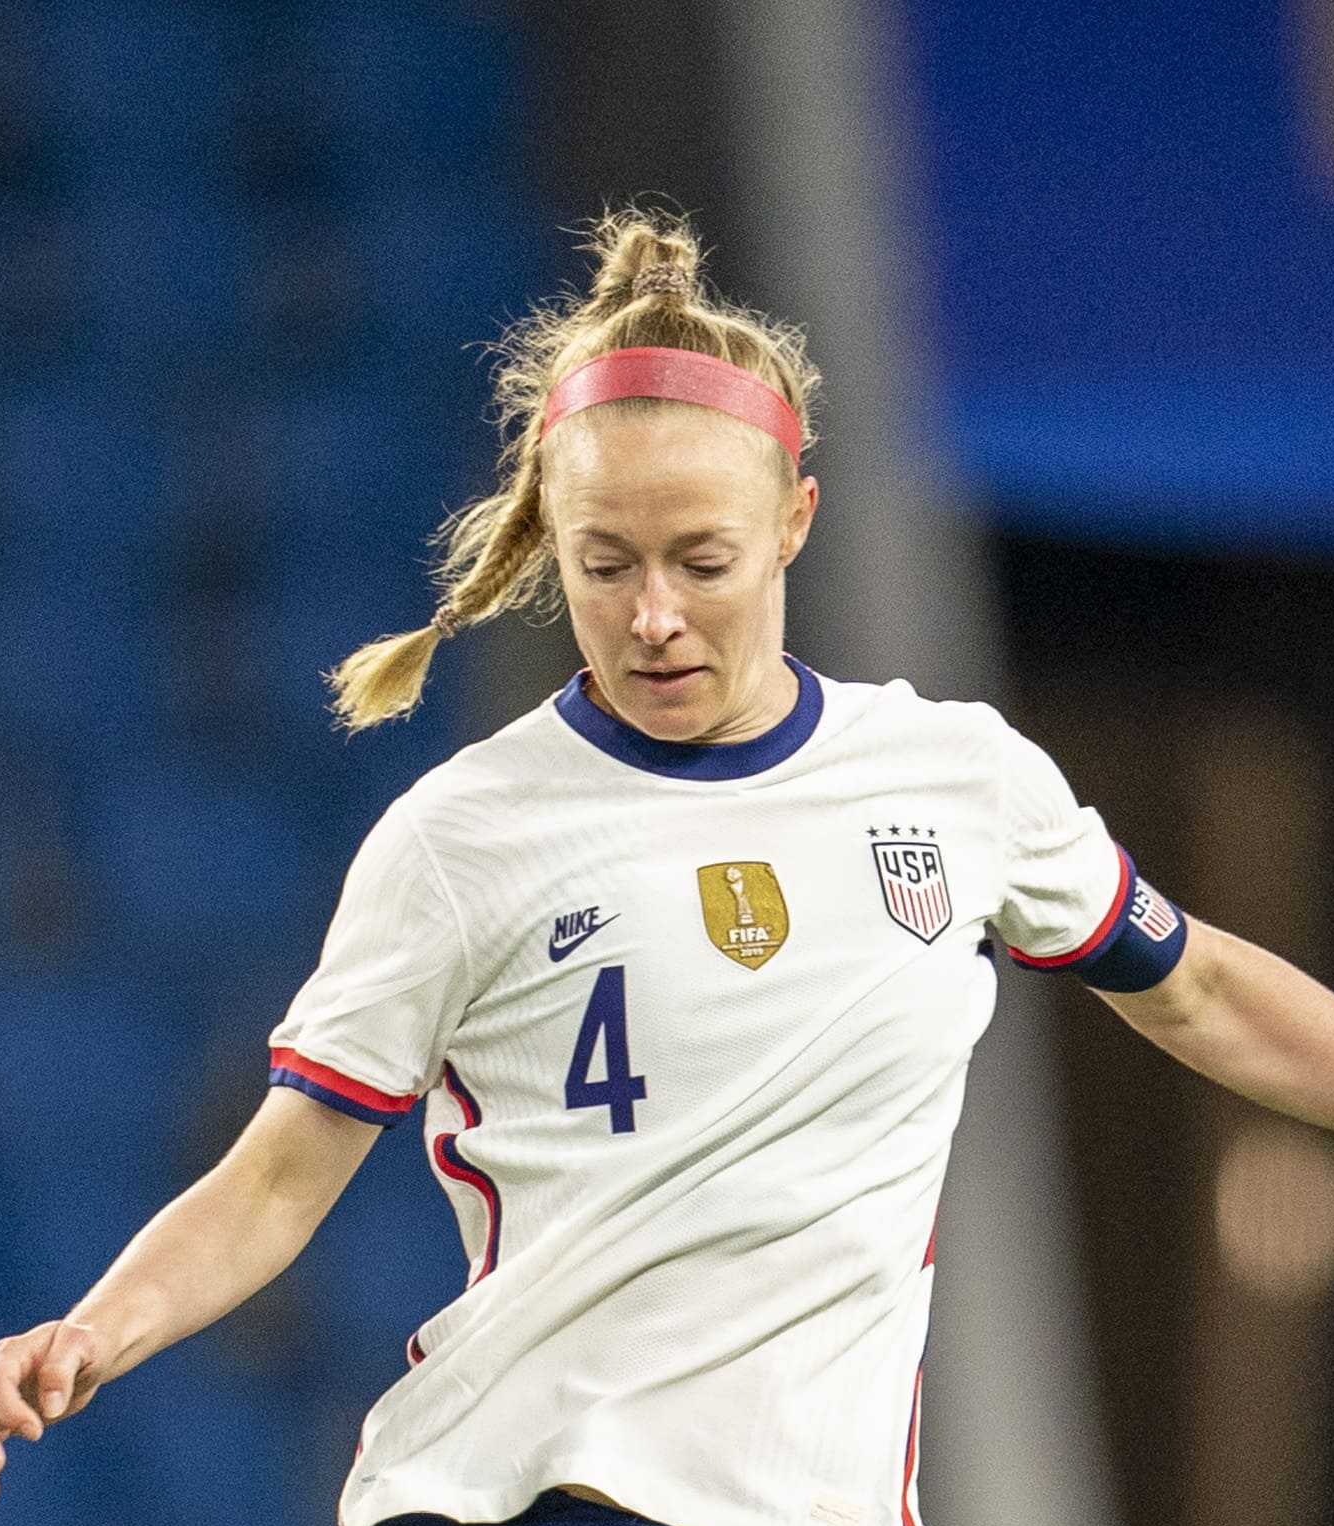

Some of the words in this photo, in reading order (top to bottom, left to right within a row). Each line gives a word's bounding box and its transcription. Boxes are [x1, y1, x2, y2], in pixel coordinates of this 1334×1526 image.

[882, 851, 938, 884] USA
[554, 905, 600, 943] NIKE
[728, 926, 770, 943] FIFA
[564, 965, 647, 1135] 4
